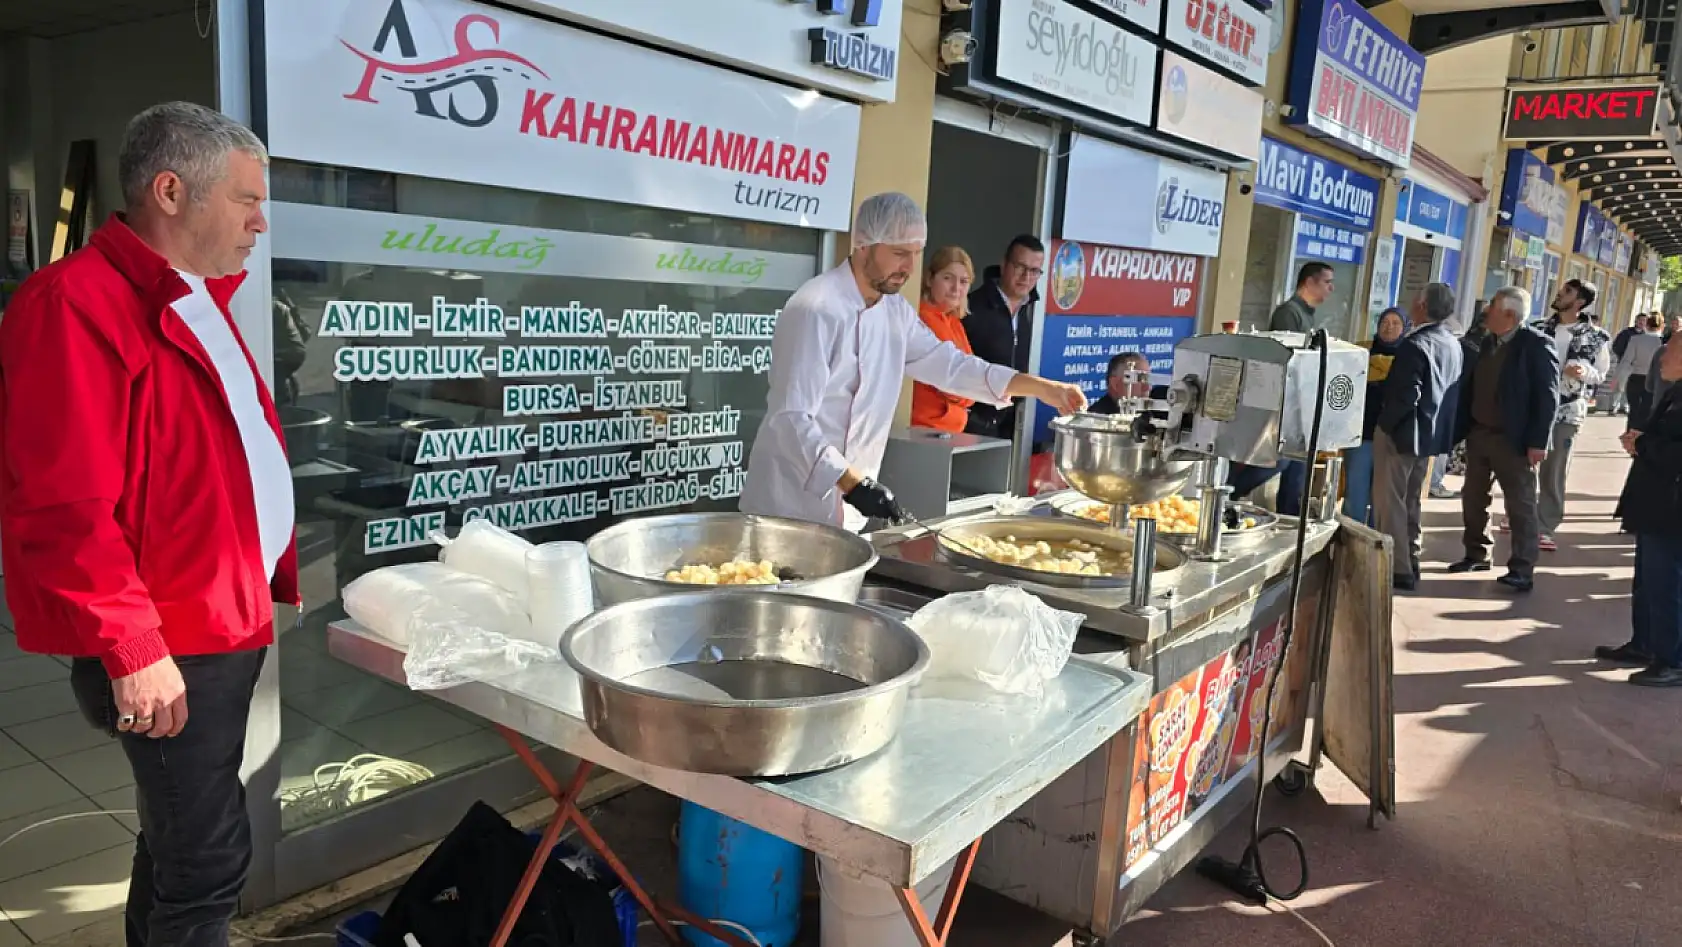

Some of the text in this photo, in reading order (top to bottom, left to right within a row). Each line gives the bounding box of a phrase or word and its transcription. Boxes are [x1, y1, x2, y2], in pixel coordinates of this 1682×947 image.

[824, 28, 896, 79] TURİZM
[1344, 16, 1422, 102] FETHİYE
[1513, 90, 1655, 121] MARKET
[519, 88, 830, 187] KAHRAMANMARAS
[734, 179, 820, 216] turizm
[1255, 140, 1374, 218] Mavi Bodrum
[380, 226, 556, 269] uludağ
[655, 247, 771, 283] uludağ
[1090, 247, 1197, 284] KAPADOKYA
[1173, 288, 1192, 308] VIP
[321, 298, 778, 338] AYDIN İZMİR MANİSA AKHİSAR BALIKES
[1099, 323, 1138, 338] İSTANBUL
[1143, 327, 1174, 338] ANKARA
[335, 347, 483, 380] SUSURLUK
[500, 346, 614, 375] BANDIRMA
[627, 341, 689, 373] GÖNEN
[703, 342, 742, 372] BİGA
[1063, 344, 1103, 357] ANTALYA
[504, 378, 686, 416] BURSA İSTANBUL
[416, 406, 740, 463] AYVALIK BURHANİYE EDREMİT
[408, 467, 496, 505] AKÇAY
[511, 455, 631, 496] ALTINOLUK
[610, 474, 700, 512] TEKİRDAĞ
